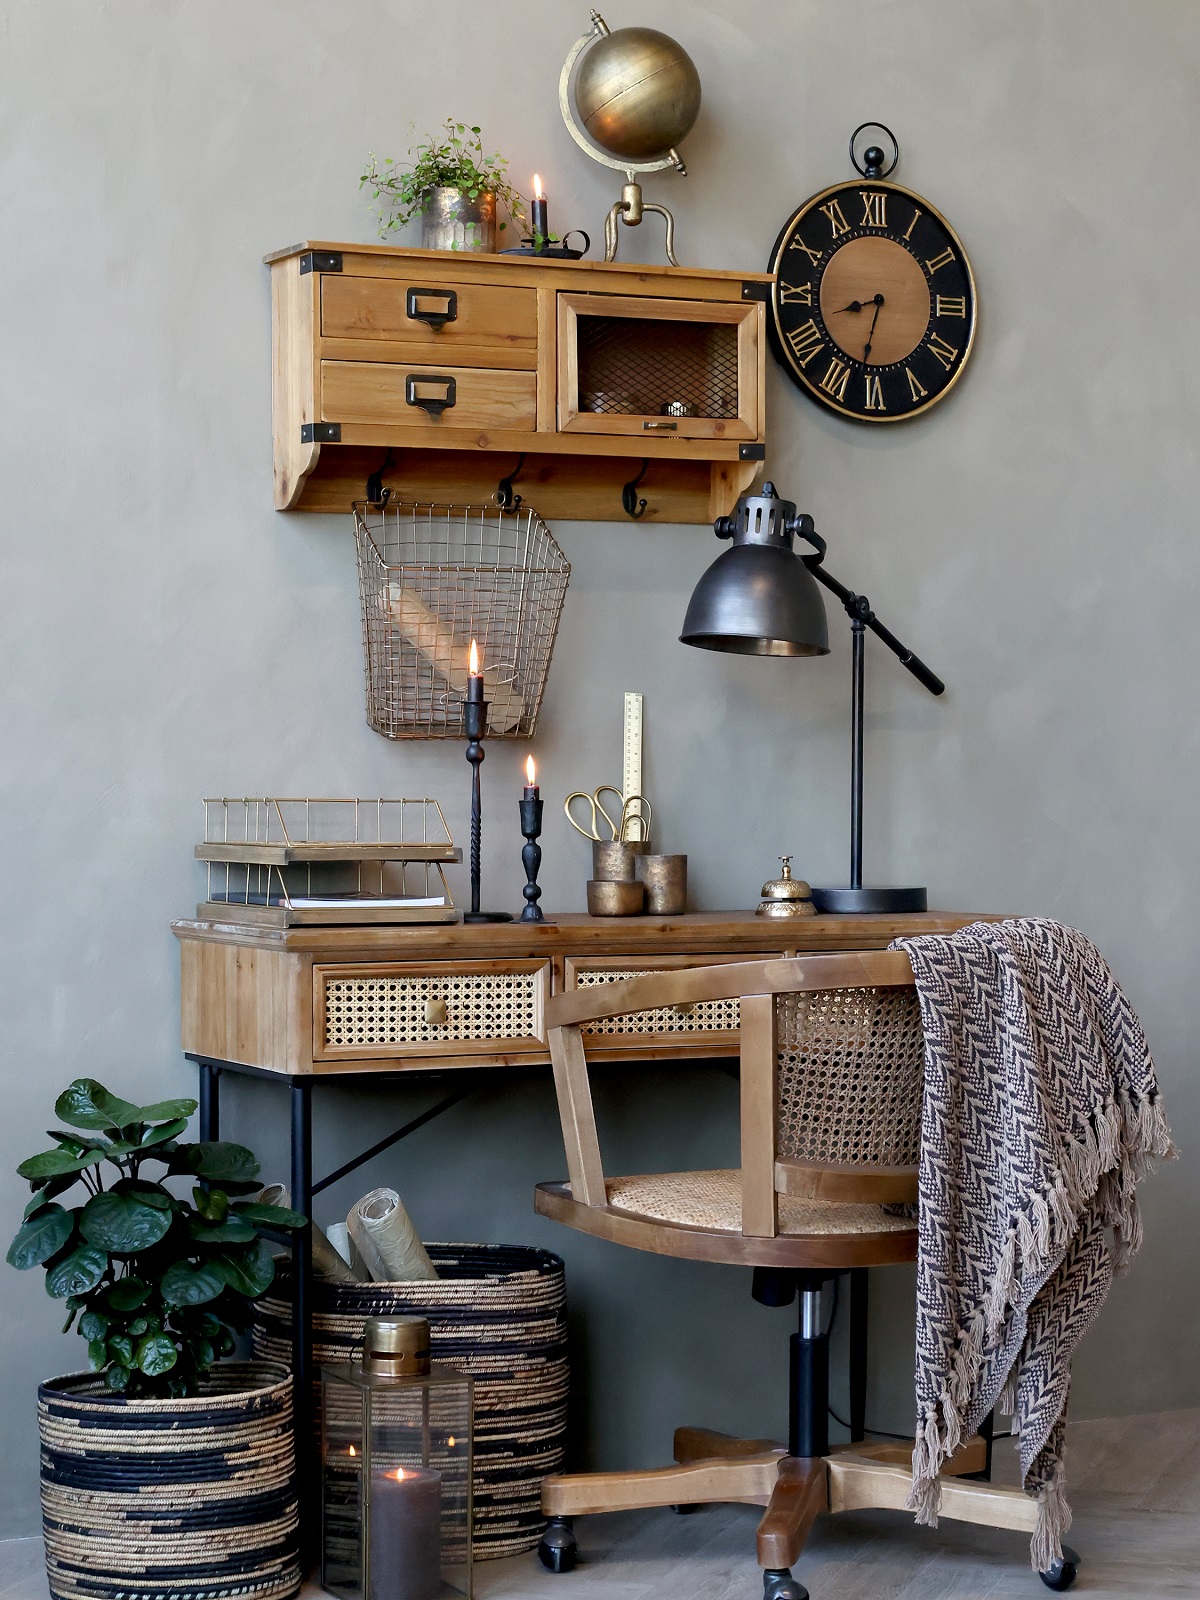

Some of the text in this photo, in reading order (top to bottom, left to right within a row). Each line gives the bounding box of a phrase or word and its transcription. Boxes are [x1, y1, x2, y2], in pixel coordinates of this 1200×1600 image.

[818, 199, 851, 239] XI
[859, 191, 888, 228] XII
[902, 209, 922, 242] I
[789, 234, 823, 267] X
[925, 246, 956, 275] II
[780, 281, 812, 306] IX
[936, 294, 966, 319] III
[786, 318, 826, 368] VIII
[926, 332, 959, 371] IV
[818, 356, 851, 402] VII
[864, 375, 887, 411] VI
[905, 367, 929, 402] V
